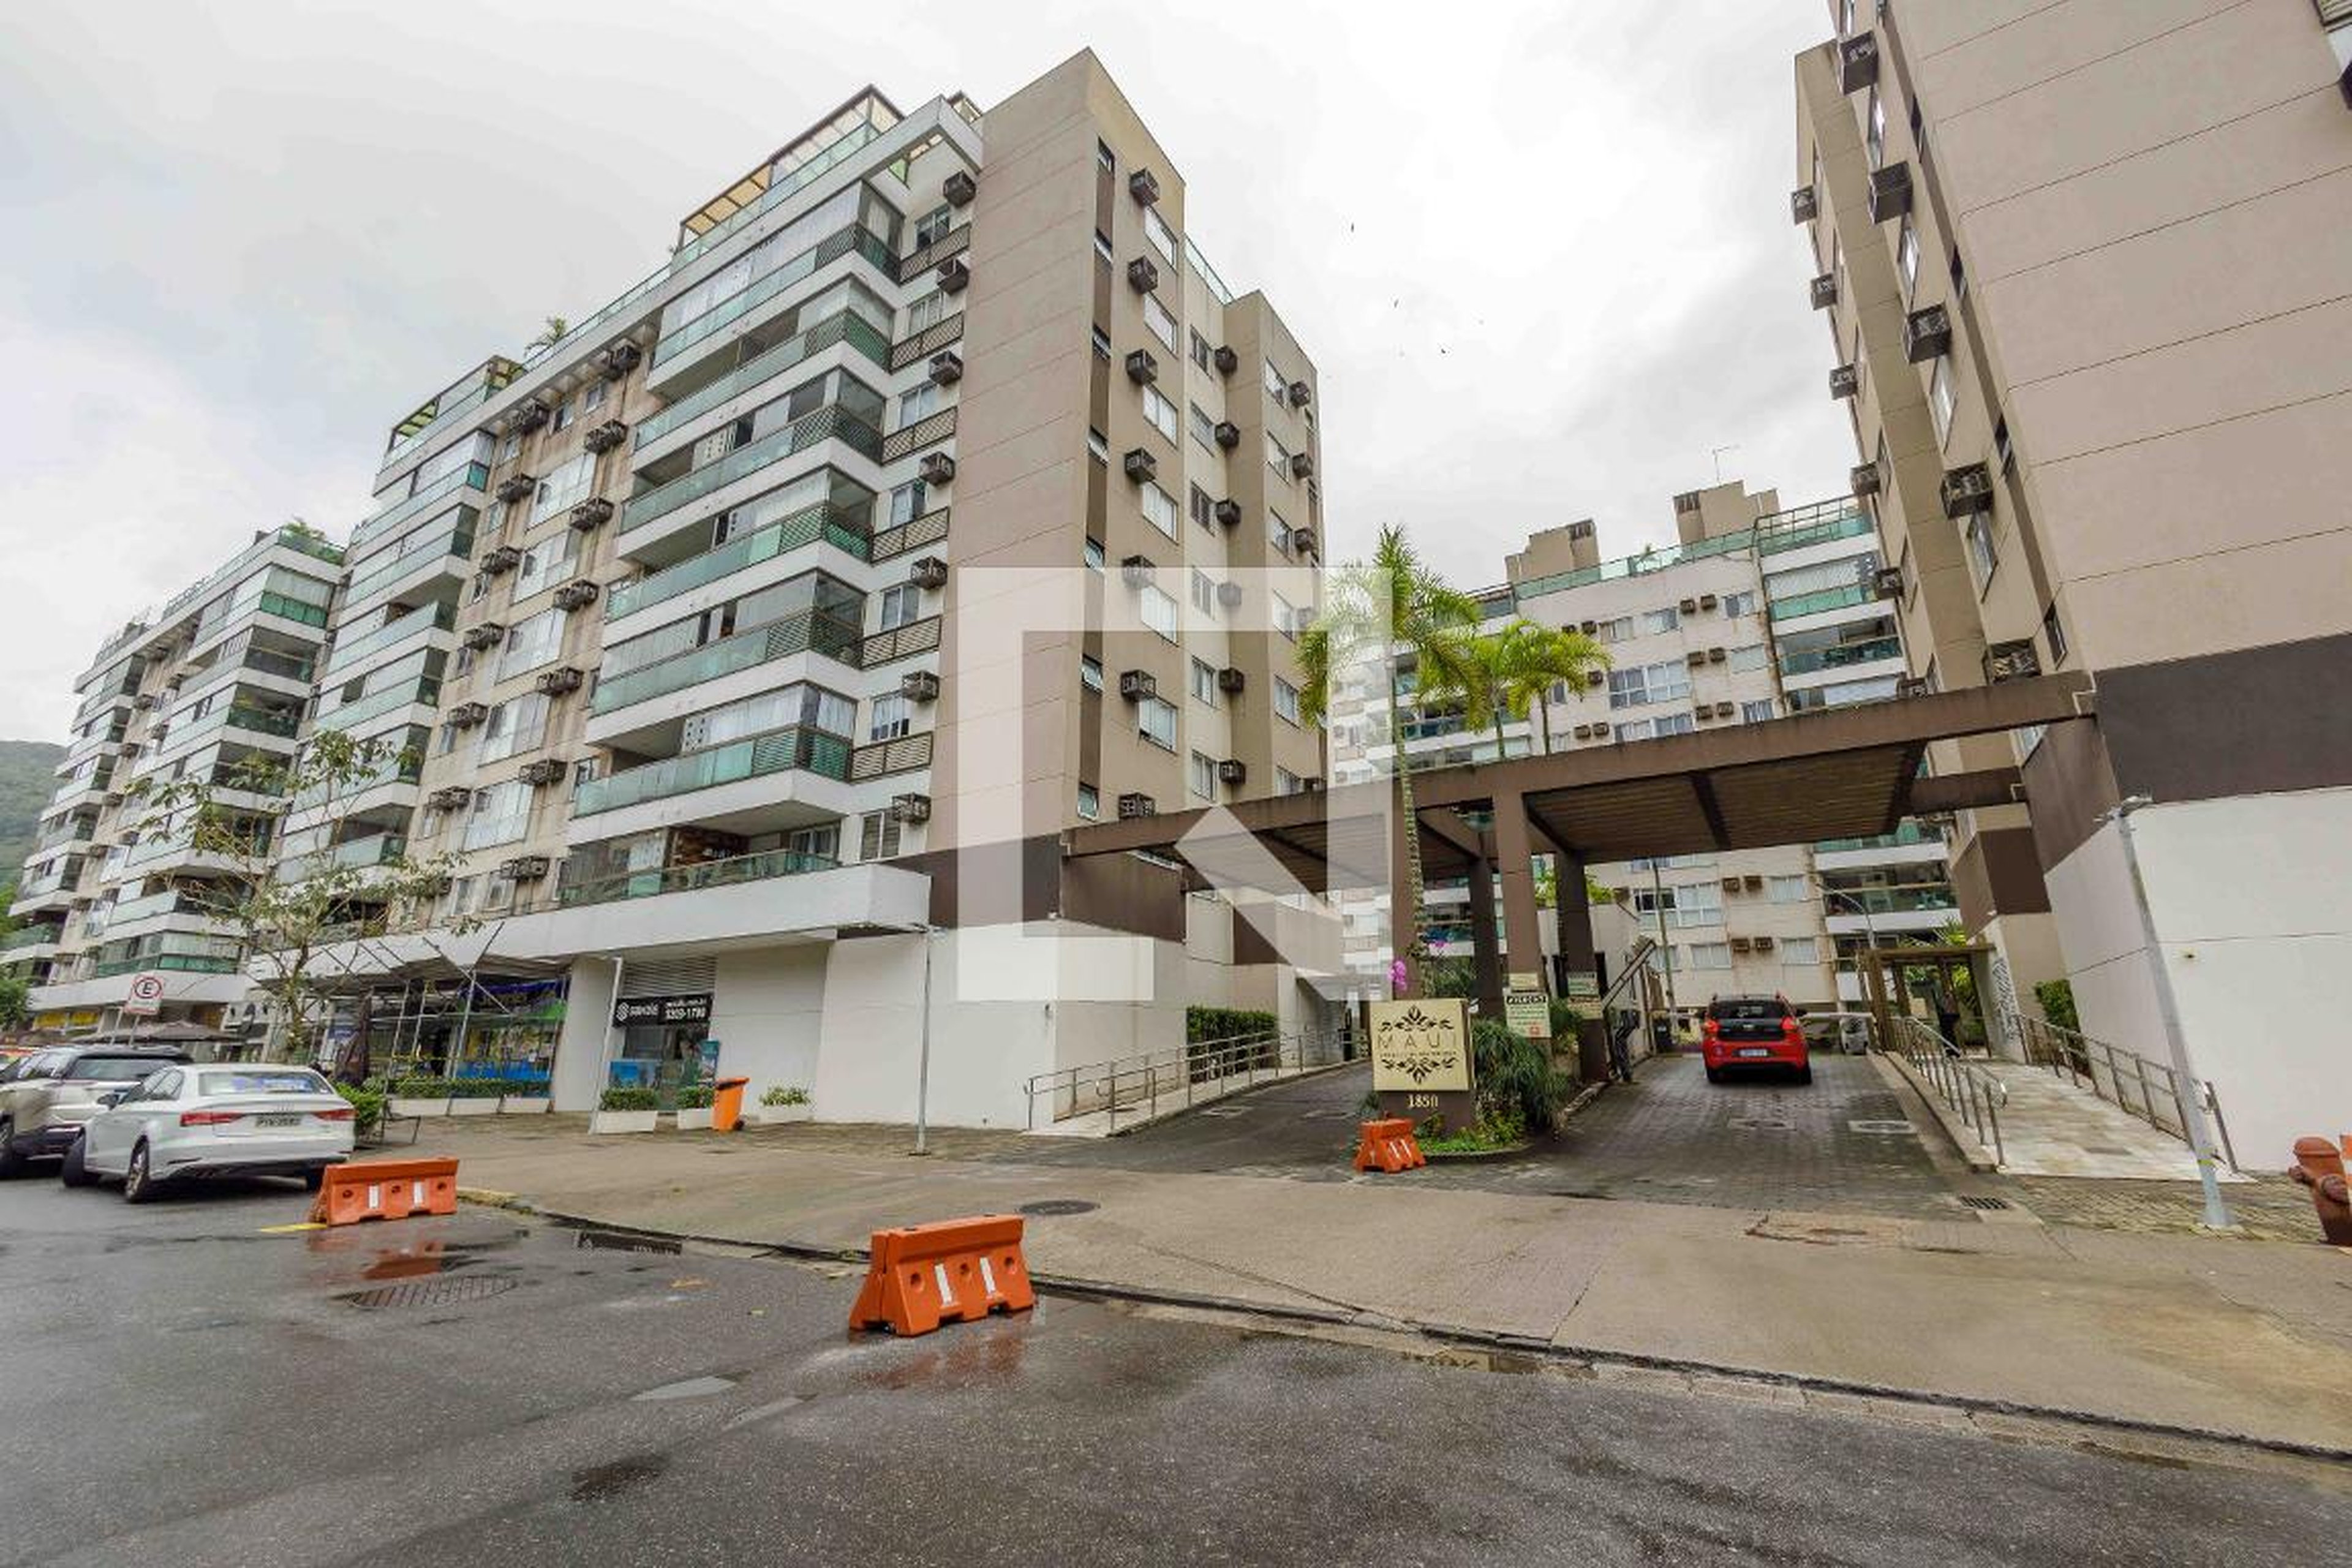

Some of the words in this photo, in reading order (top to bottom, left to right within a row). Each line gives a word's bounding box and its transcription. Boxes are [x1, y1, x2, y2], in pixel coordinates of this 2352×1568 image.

[142, 981, 154, 995] E
[1378, 1034, 1457, 1049] MAUI
[1408, 1093, 1439, 1107] 1850
